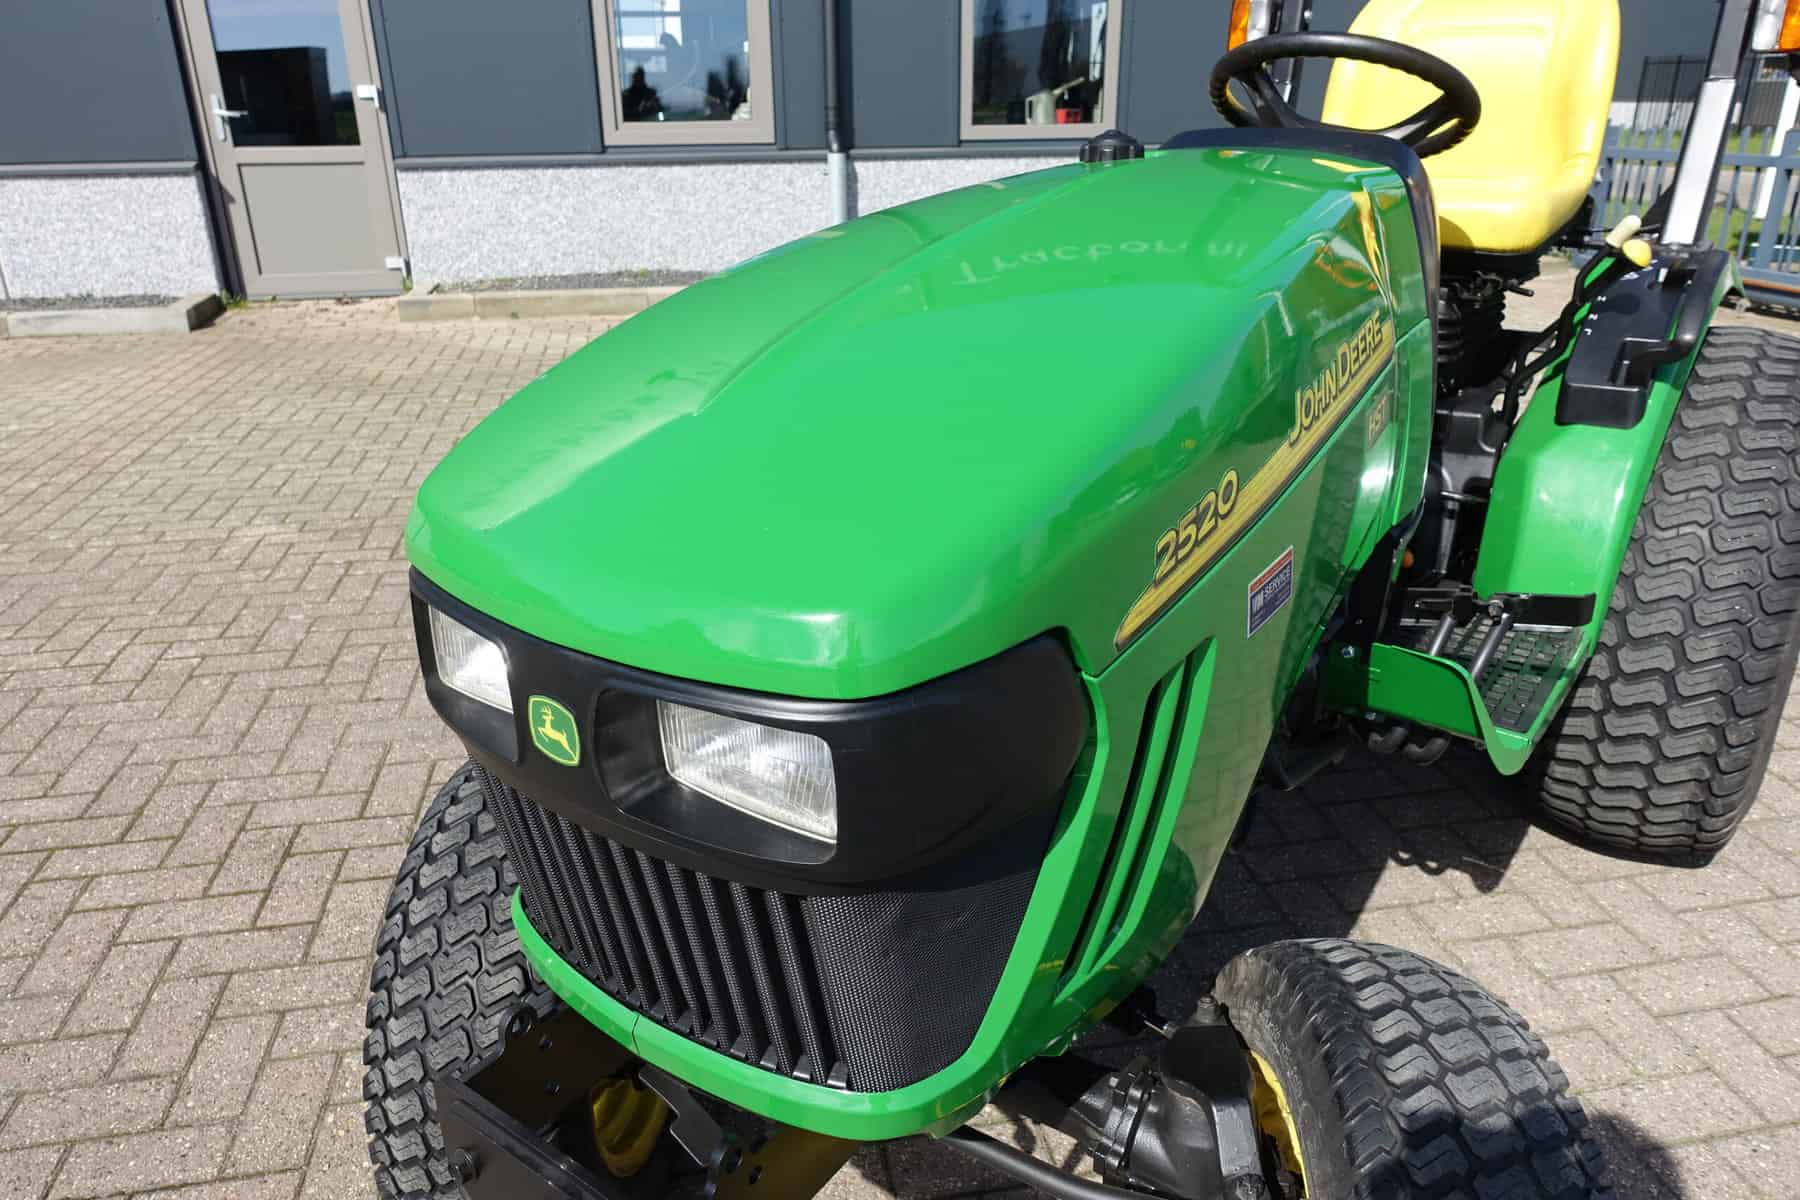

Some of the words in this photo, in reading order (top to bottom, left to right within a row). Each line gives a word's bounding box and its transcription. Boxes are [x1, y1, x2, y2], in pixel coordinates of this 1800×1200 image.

[1288, 359, 1337, 445] JOHN
[1337, 308, 1383, 390] DEERE
[1154, 468, 1239, 585] 2520
